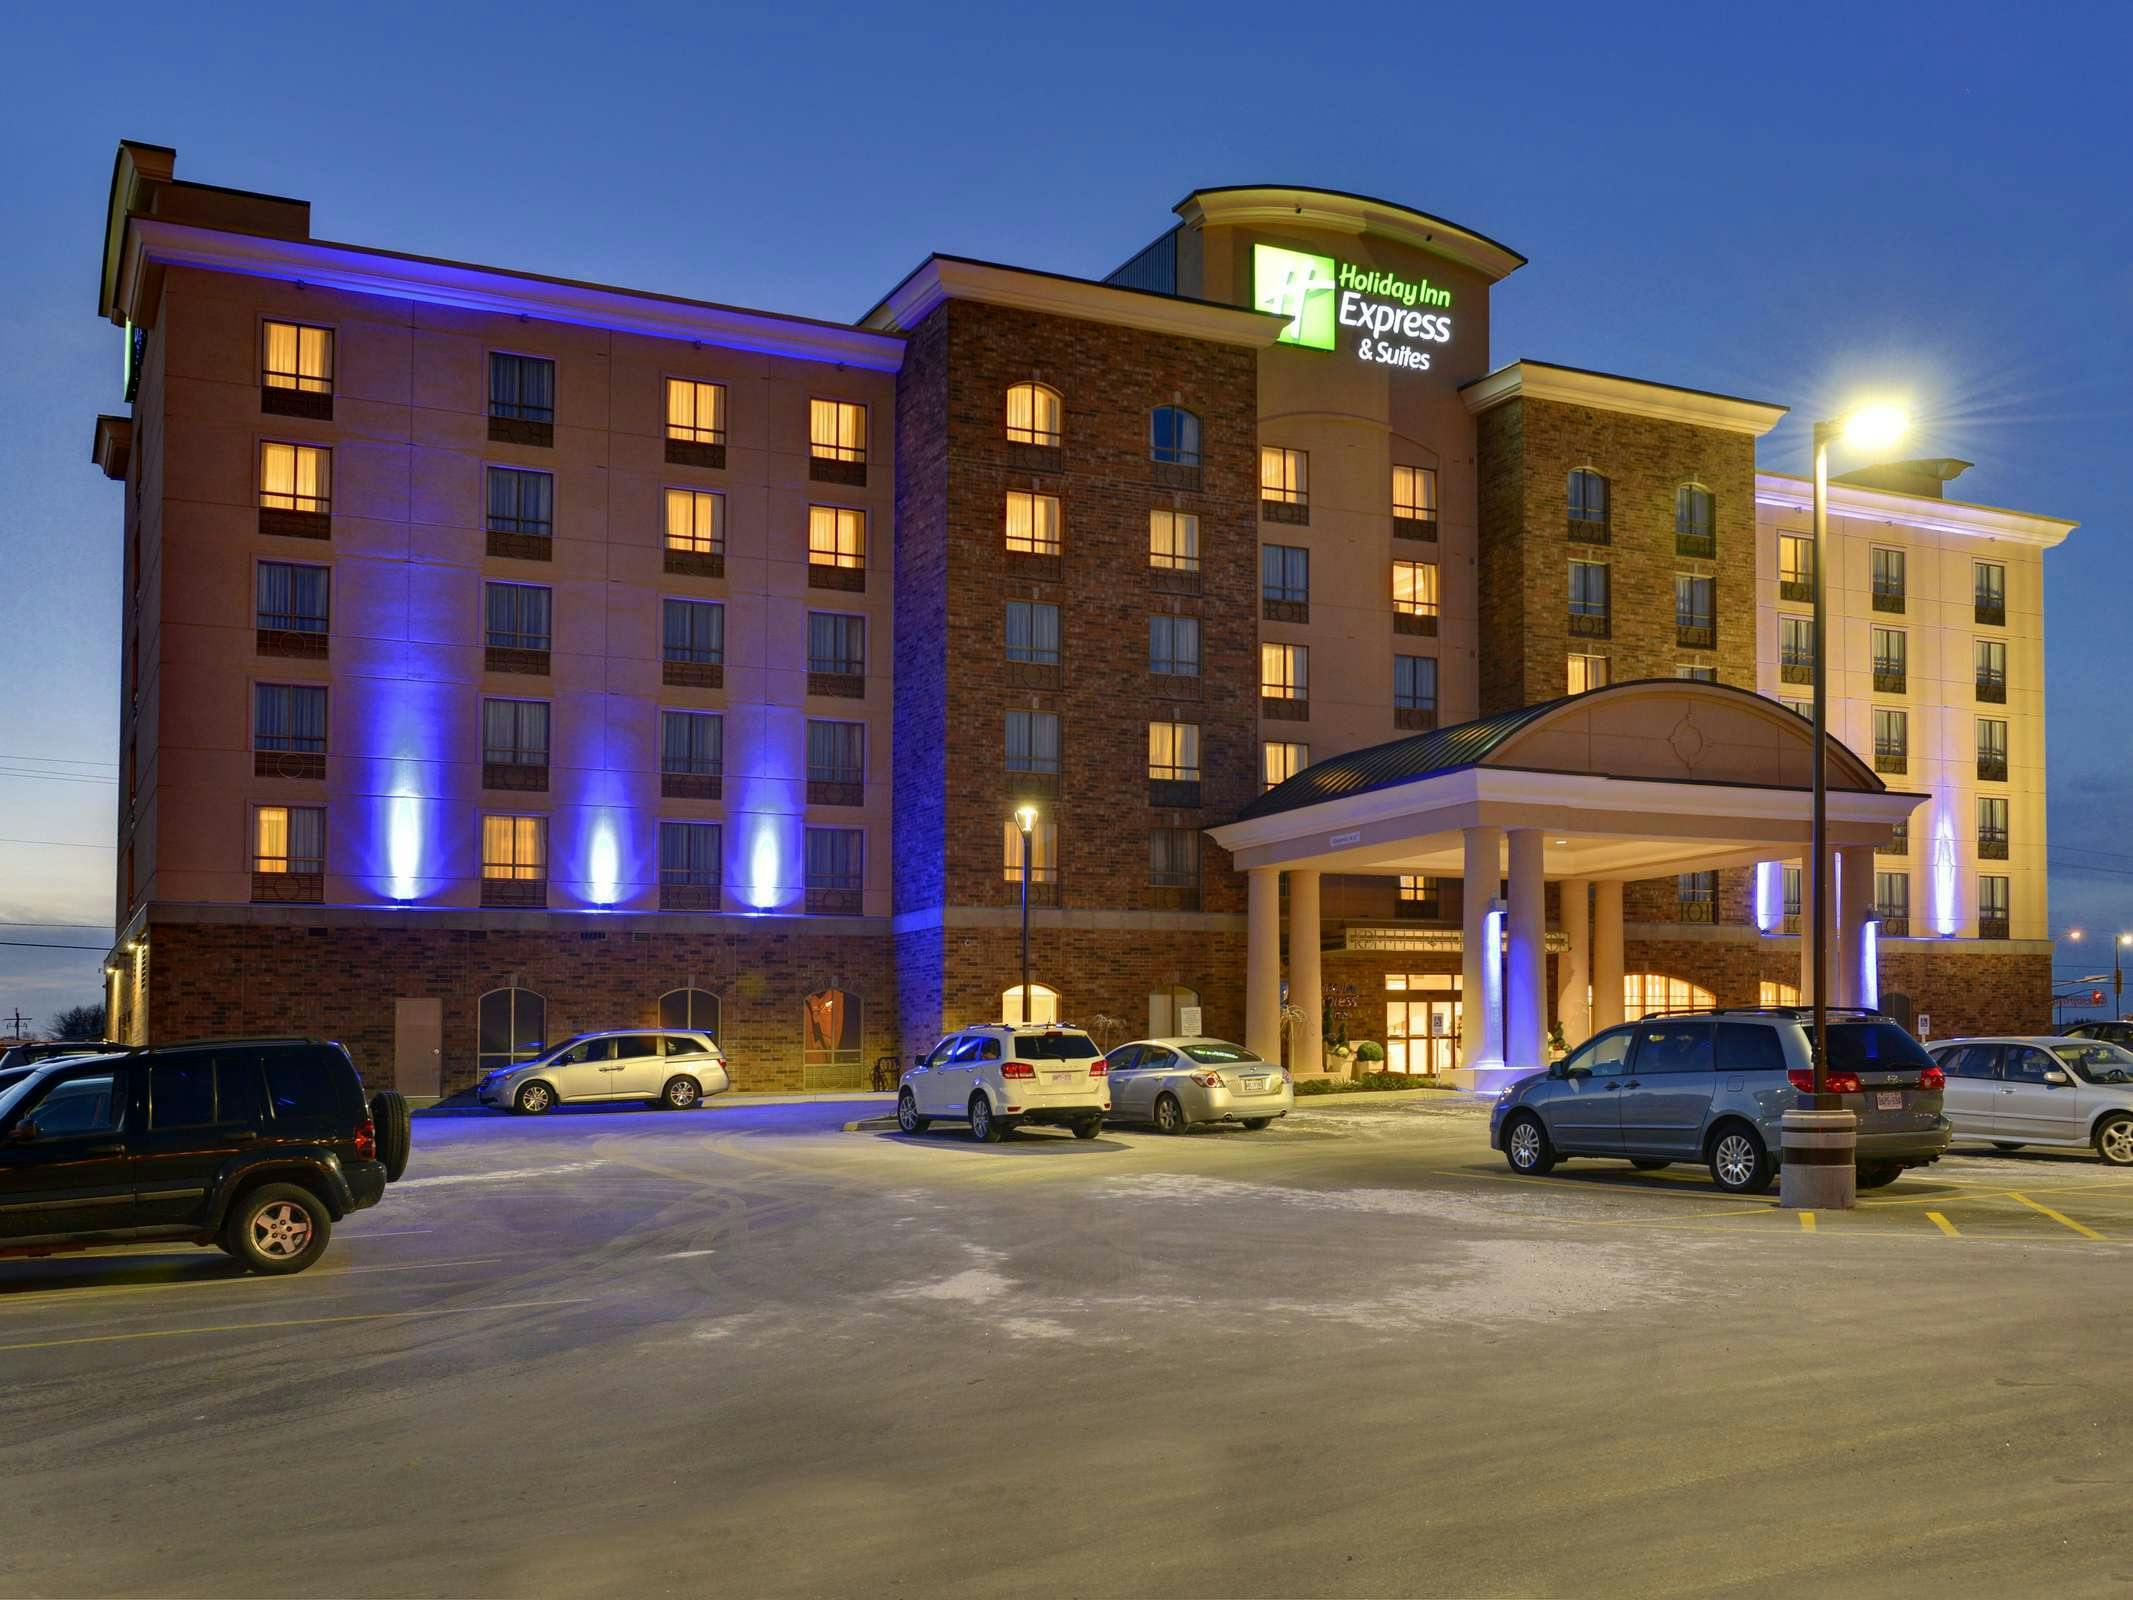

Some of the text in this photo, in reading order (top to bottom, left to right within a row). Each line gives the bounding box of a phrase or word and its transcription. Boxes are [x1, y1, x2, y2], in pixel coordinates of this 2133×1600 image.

[1339, 263, 1451, 308] Holiday Inn
[1338, 291, 1451, 343] Express
[1358, 338, 1430, 370] & Suites
